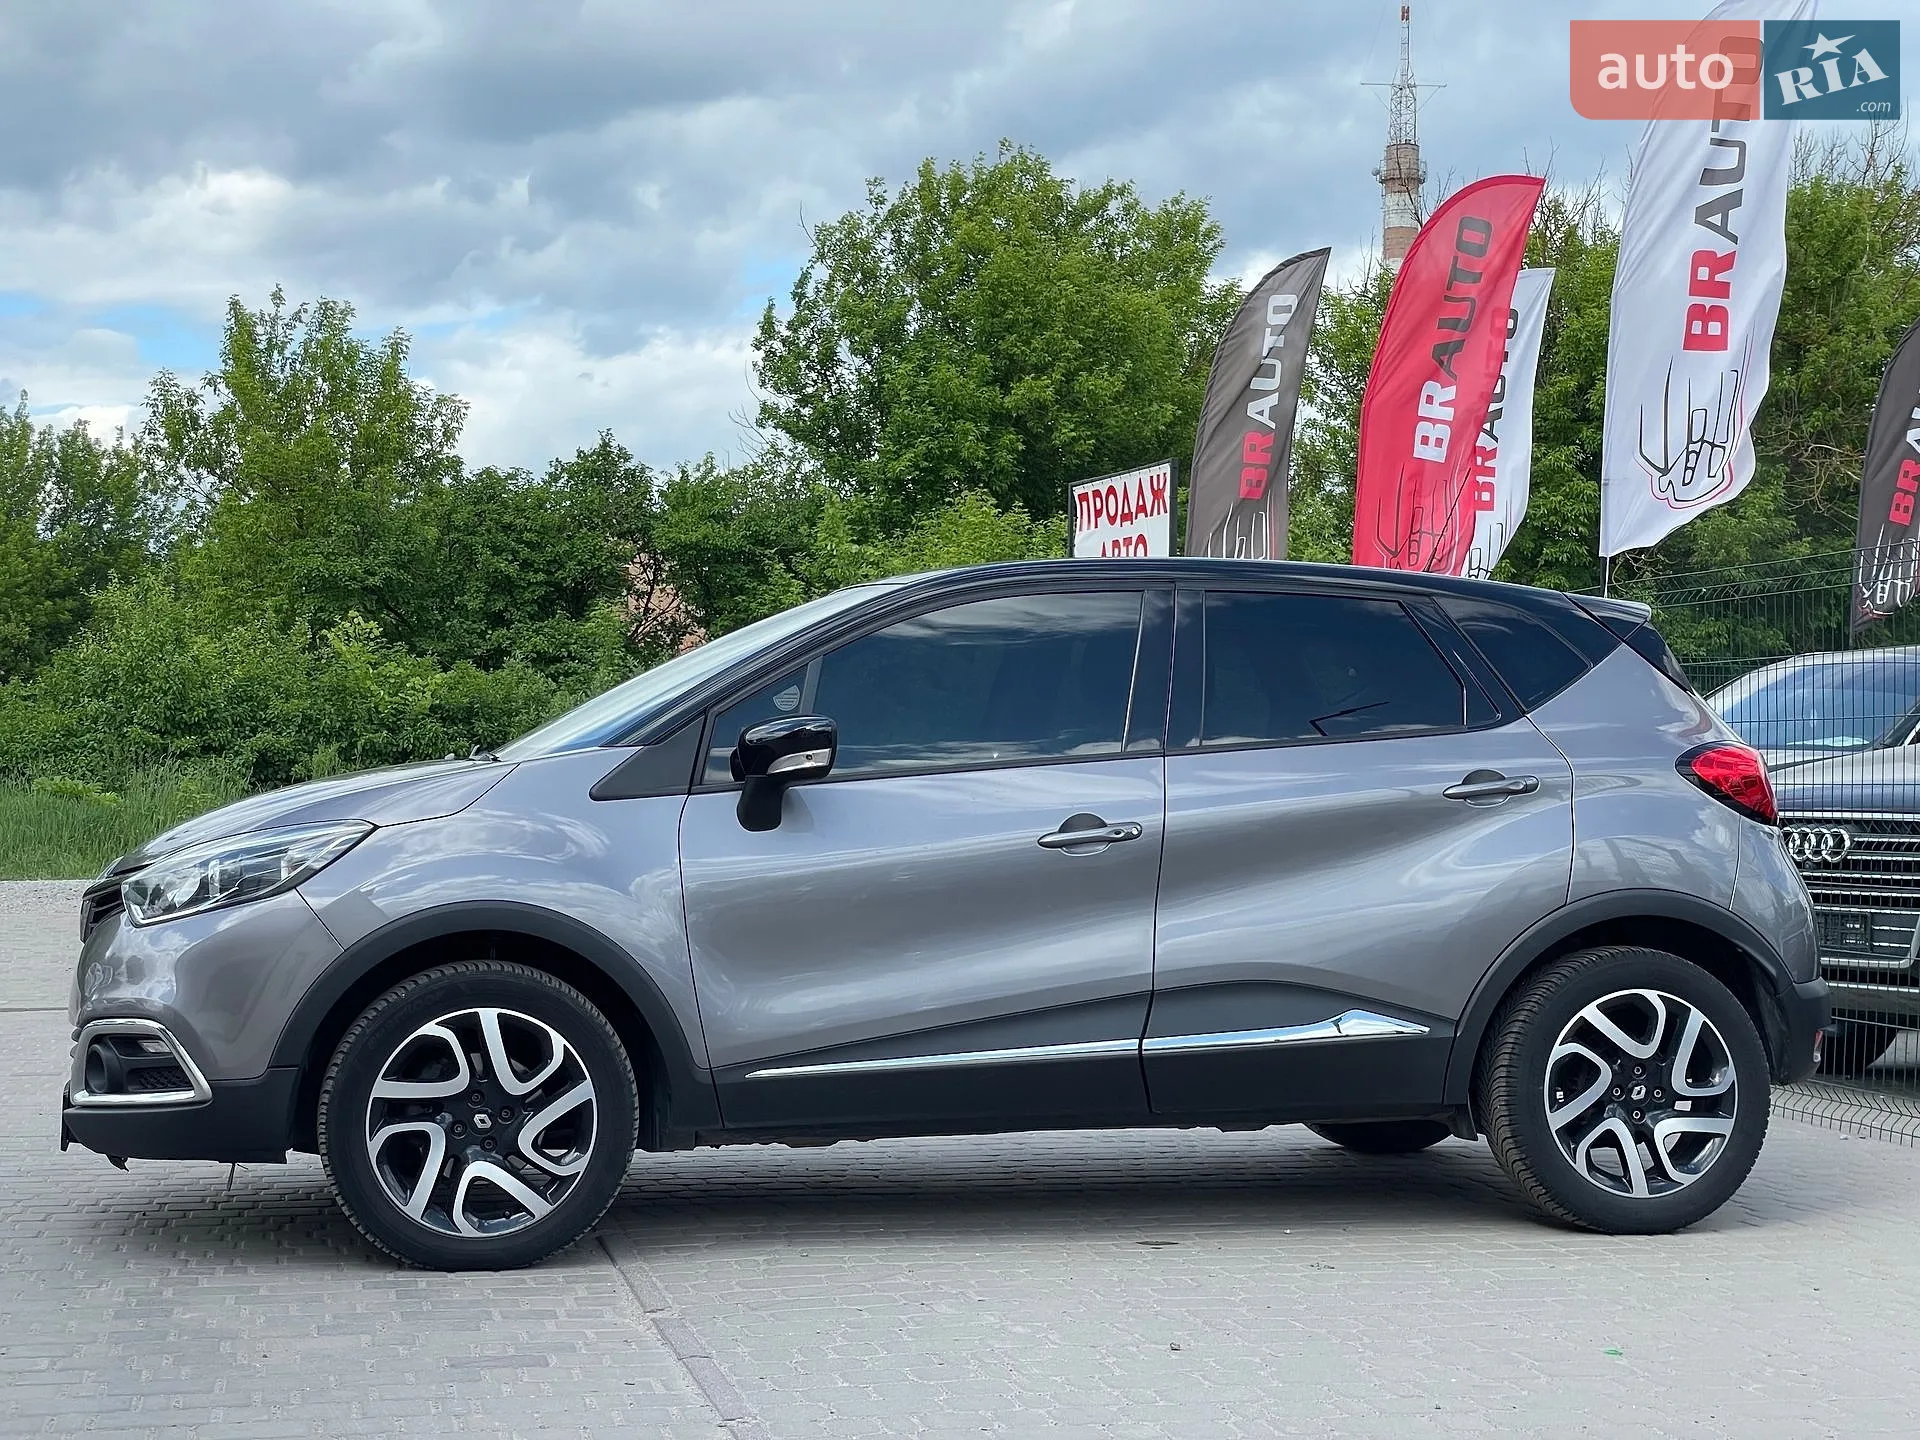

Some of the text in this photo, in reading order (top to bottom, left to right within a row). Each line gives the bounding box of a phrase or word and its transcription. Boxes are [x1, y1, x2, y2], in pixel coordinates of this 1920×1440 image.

[1682, 36, 1764, 351] BRAUTO
[1238, 293, 1298, 500] BRAUTO
[1413, 215, 1493, 464] BRAUTO
[1077, 472, 1168, 532] ПРОДАЖ
